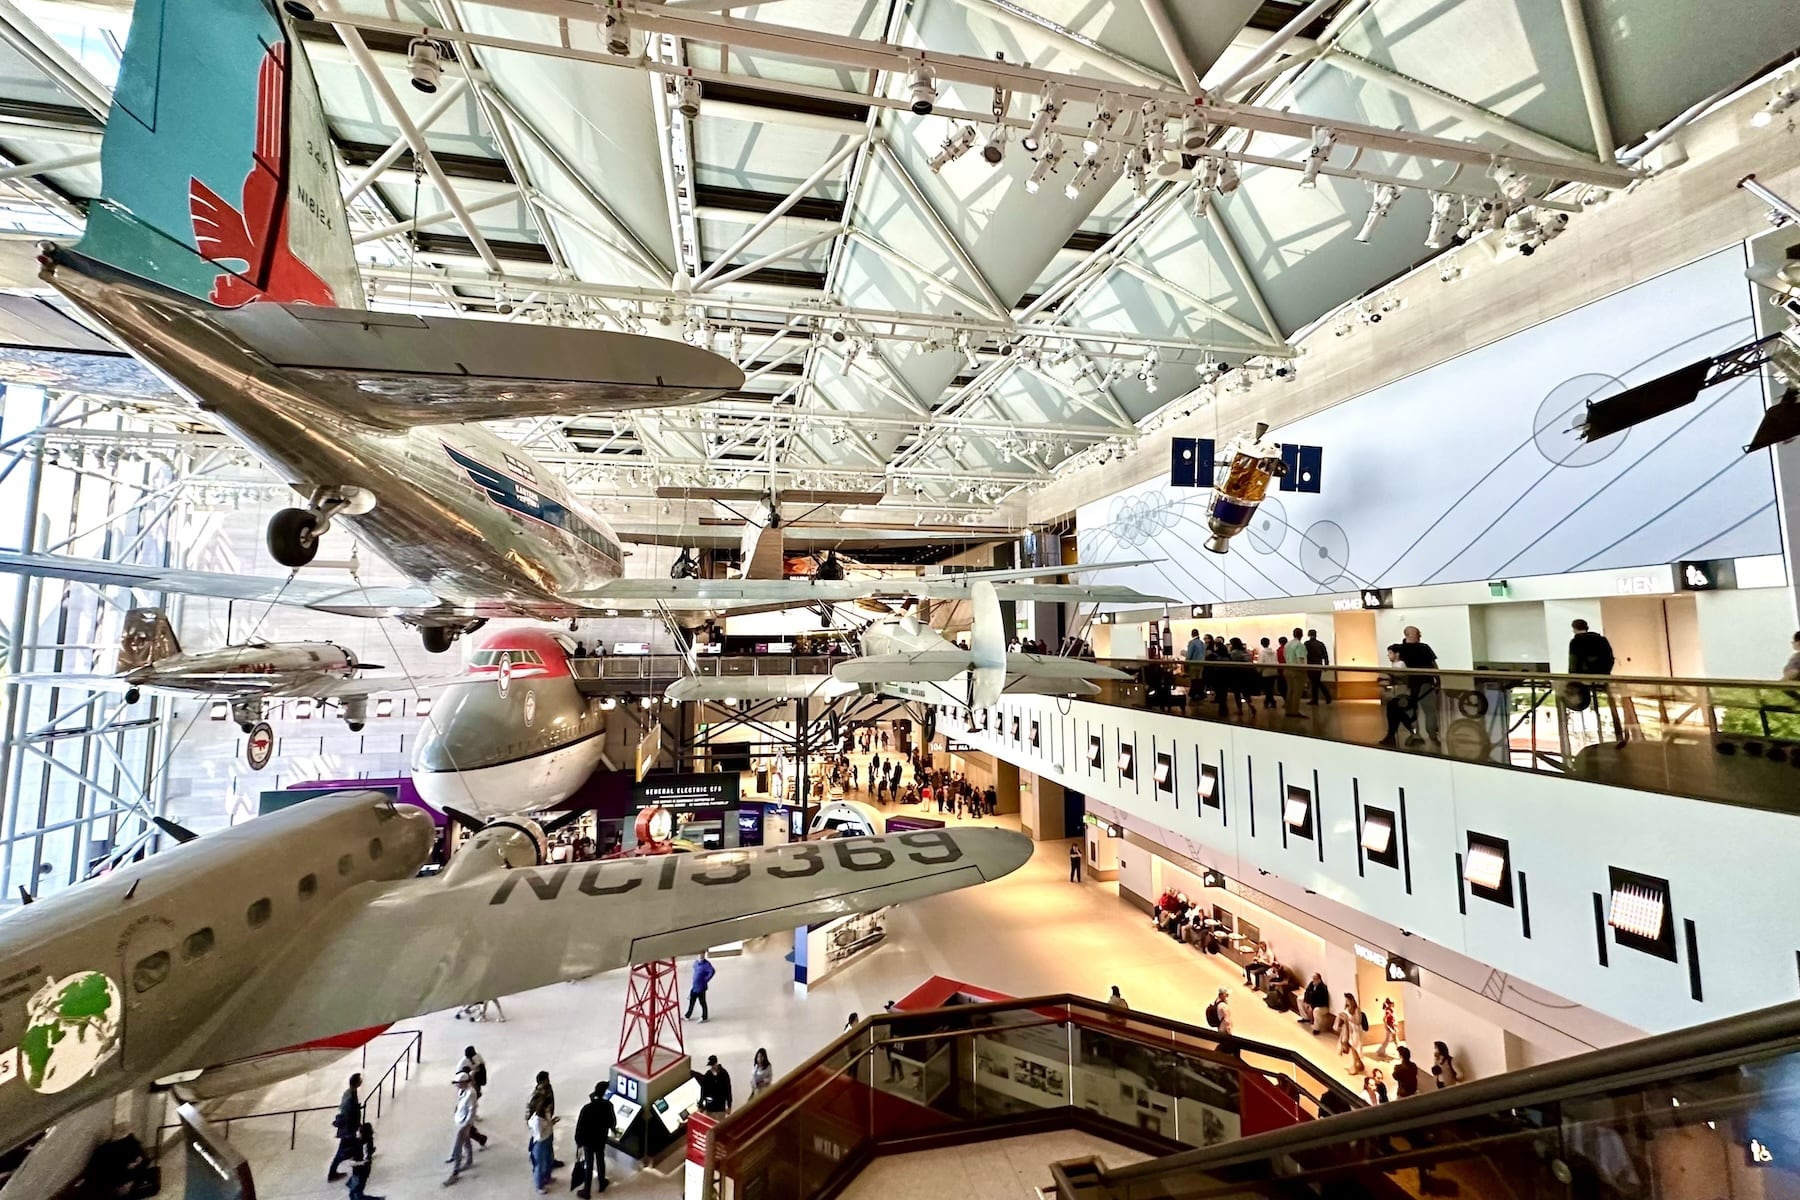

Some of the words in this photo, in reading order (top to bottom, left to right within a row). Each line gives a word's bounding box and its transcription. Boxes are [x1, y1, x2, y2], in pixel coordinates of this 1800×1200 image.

[1616, 576, 1657, 593] MEN
[930, 742, 943, 751] 106
[645, 787, 674, 796] GENERAL
[676, 786, 707, 794] ELECTRIC
[491, 831, 963, 905] NC13369
